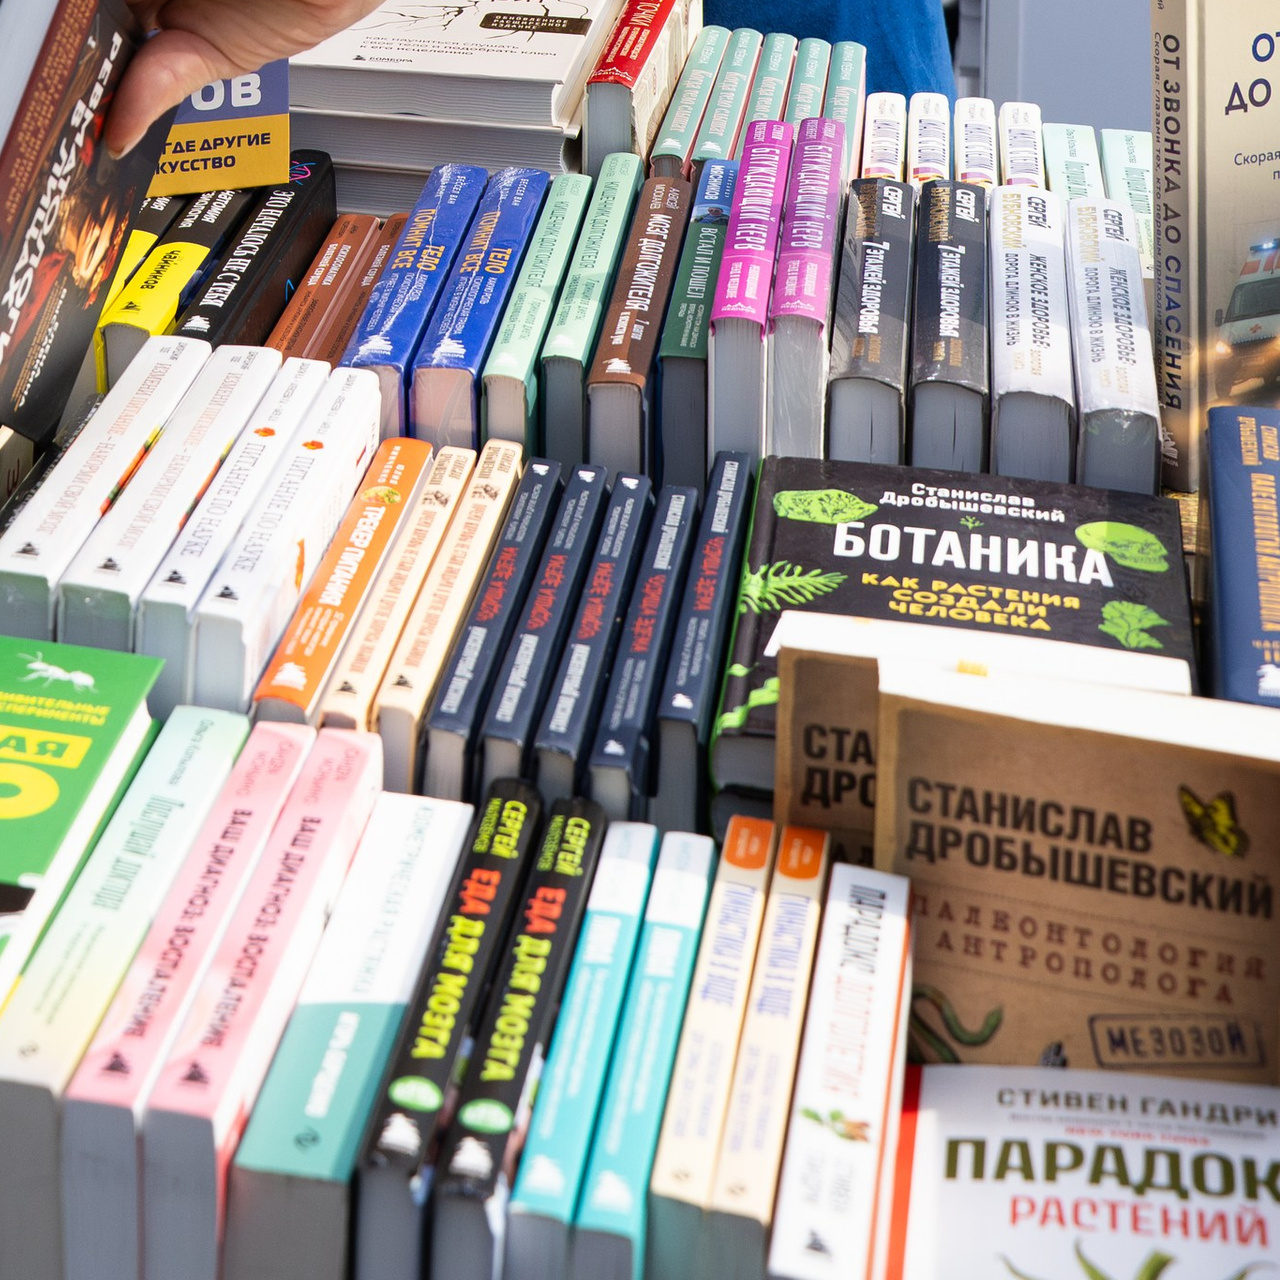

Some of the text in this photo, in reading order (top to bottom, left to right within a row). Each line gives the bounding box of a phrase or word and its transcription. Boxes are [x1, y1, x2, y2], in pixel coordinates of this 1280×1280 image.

[628, 0, 658, 27] ТОЧКИ
[1225, 78, 1271, 115] ДО
[200, 132, 271, 151] ДРУГИЕ
[726, 144, 782, 252] БЛУЖДАЮЩИЙ НЕРВ
[882, 185, 906, 219] СЕРГЕЙ
[955, 189, 980, 223] СЕРГЕЙ
[1027, 196, 1051, 230] СЕРГЕЙ
[404, 209, 436, 251] ПОМНИТ
[1103, 208, 1130, 242] СЕРГЕЙ
[1162, 34, 1182, 411] ОТ ЗВОНКА ДО СПАСЕНИЯ
[199, 190, 296, 307] ЭТО НАЧАЛОСЬ НЕ ТЕБЯ
[321, 244, 350, 286] ПСИХОСОМАТИКА
[416, 246, 445, 271] ТЕЛО
[488, 247, 512, 273] ТЕЛО
[625, 214, 672, 312] МОЗГ ДОЛГОЖИТЕЛЯ
[686, 227, 718, 299] ВСТАЛ ПОШЕЛ
[858, 241, 890, 334] 7 ЭТАЖЕЙ ЗДОРОВЬЯ
[938, 244, 965, 337] 7 ЭТАЖЕЙ ЗДОРОВЬЯ
[1030, 254, 1051, 348] ЖЕНСКОЕ ЗДОРОВЬЕ:
[1109, 267, 1132, 310] ЖЕНСКОЕ
[879, 490, 1066, 524] Дробышевский
[911, 482, 1036, 509] Станислав
[832, 521, 1115, 589] БОТАНИКА
[860, 571, 1082, 610] КАК РАСТЕНИЯ
[892, 588, 1049, 618] СОЗДАЛИ
[888, 600, 1052, 632] ЧЕЛОВЕКА
[490, 799, 528, 860] СЕРГЕЙ
[906, 775, 1154, 855] СТАНИСЛАВ
[556, 816, 592, 877] СЕРГЕЙ
[905, 819, 1275, 921] ДРОБЫШЕВСКИЙ
[410, 867, 502, 1060] ЕДА МОЗГА
[480, 887, 567, 1082] ЕДА МОЗГА
[935, 930, 1236, 1005] АНТРОПОЛОГА
[1107, 1022, 1249, 1058] МЕЗОЗОЙ
[997, 1087, 1129, 1113] СТИВЕН
[1010, 1194, 1270, 1248] РАСТЕНИЙ
